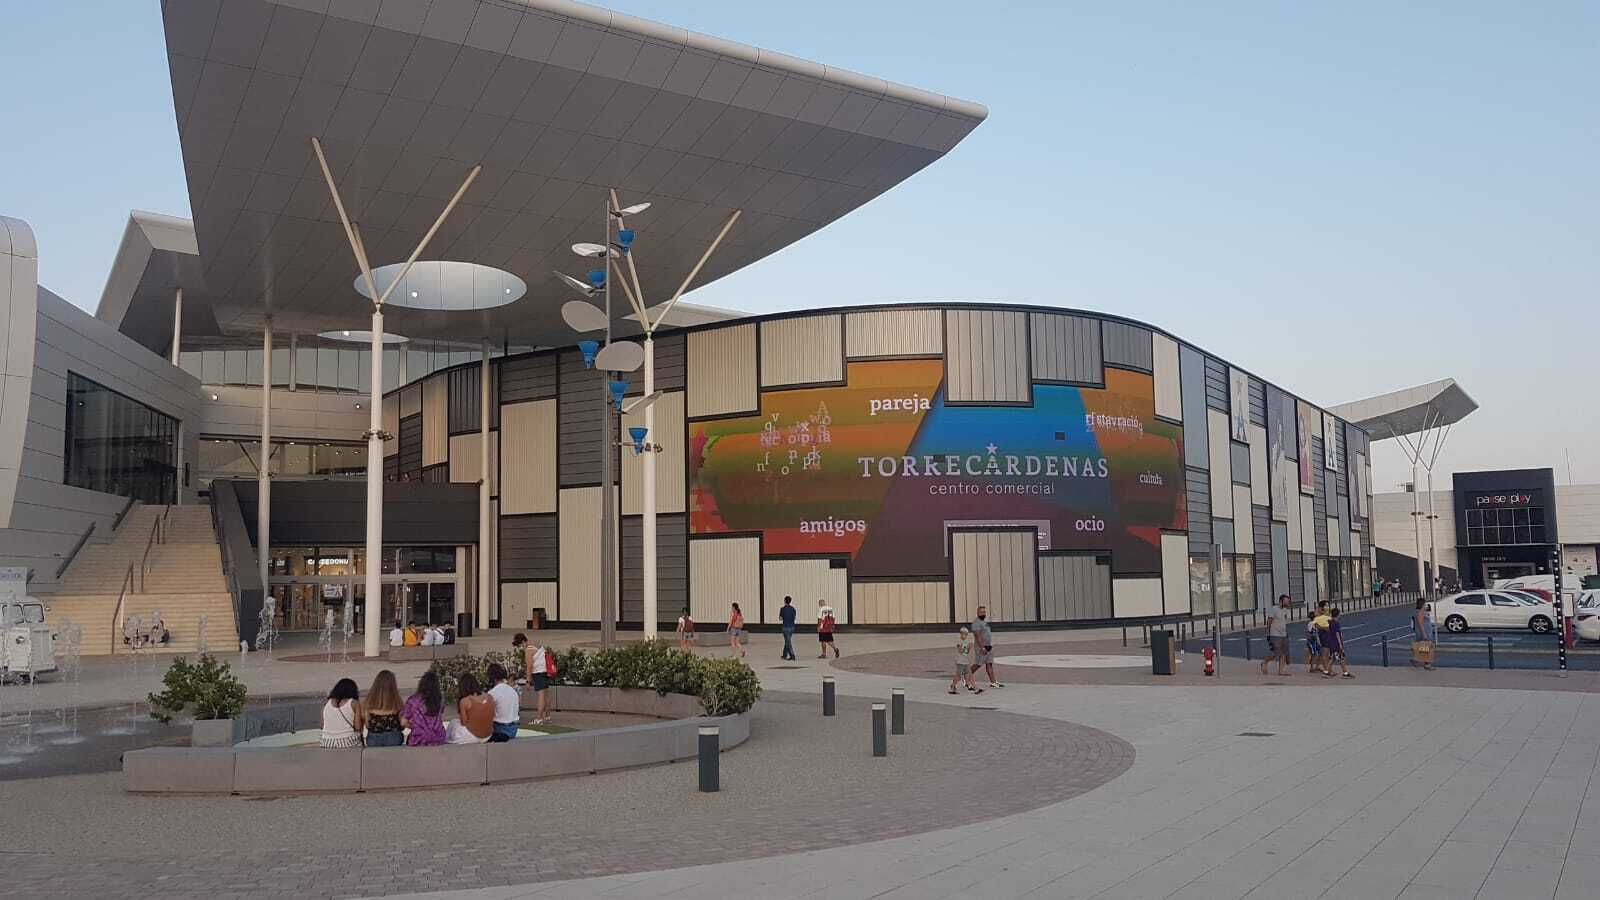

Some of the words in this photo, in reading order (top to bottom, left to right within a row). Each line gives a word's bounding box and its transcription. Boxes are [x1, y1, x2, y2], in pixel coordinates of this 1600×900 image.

[870, 394, 931, 416] pareja
[929, 481, 980, 496] centro
[985, 481, 1056, 496] comercial
[800, 516, 867, 537] amigos
[1075, 515, 1105, 532] ocio
